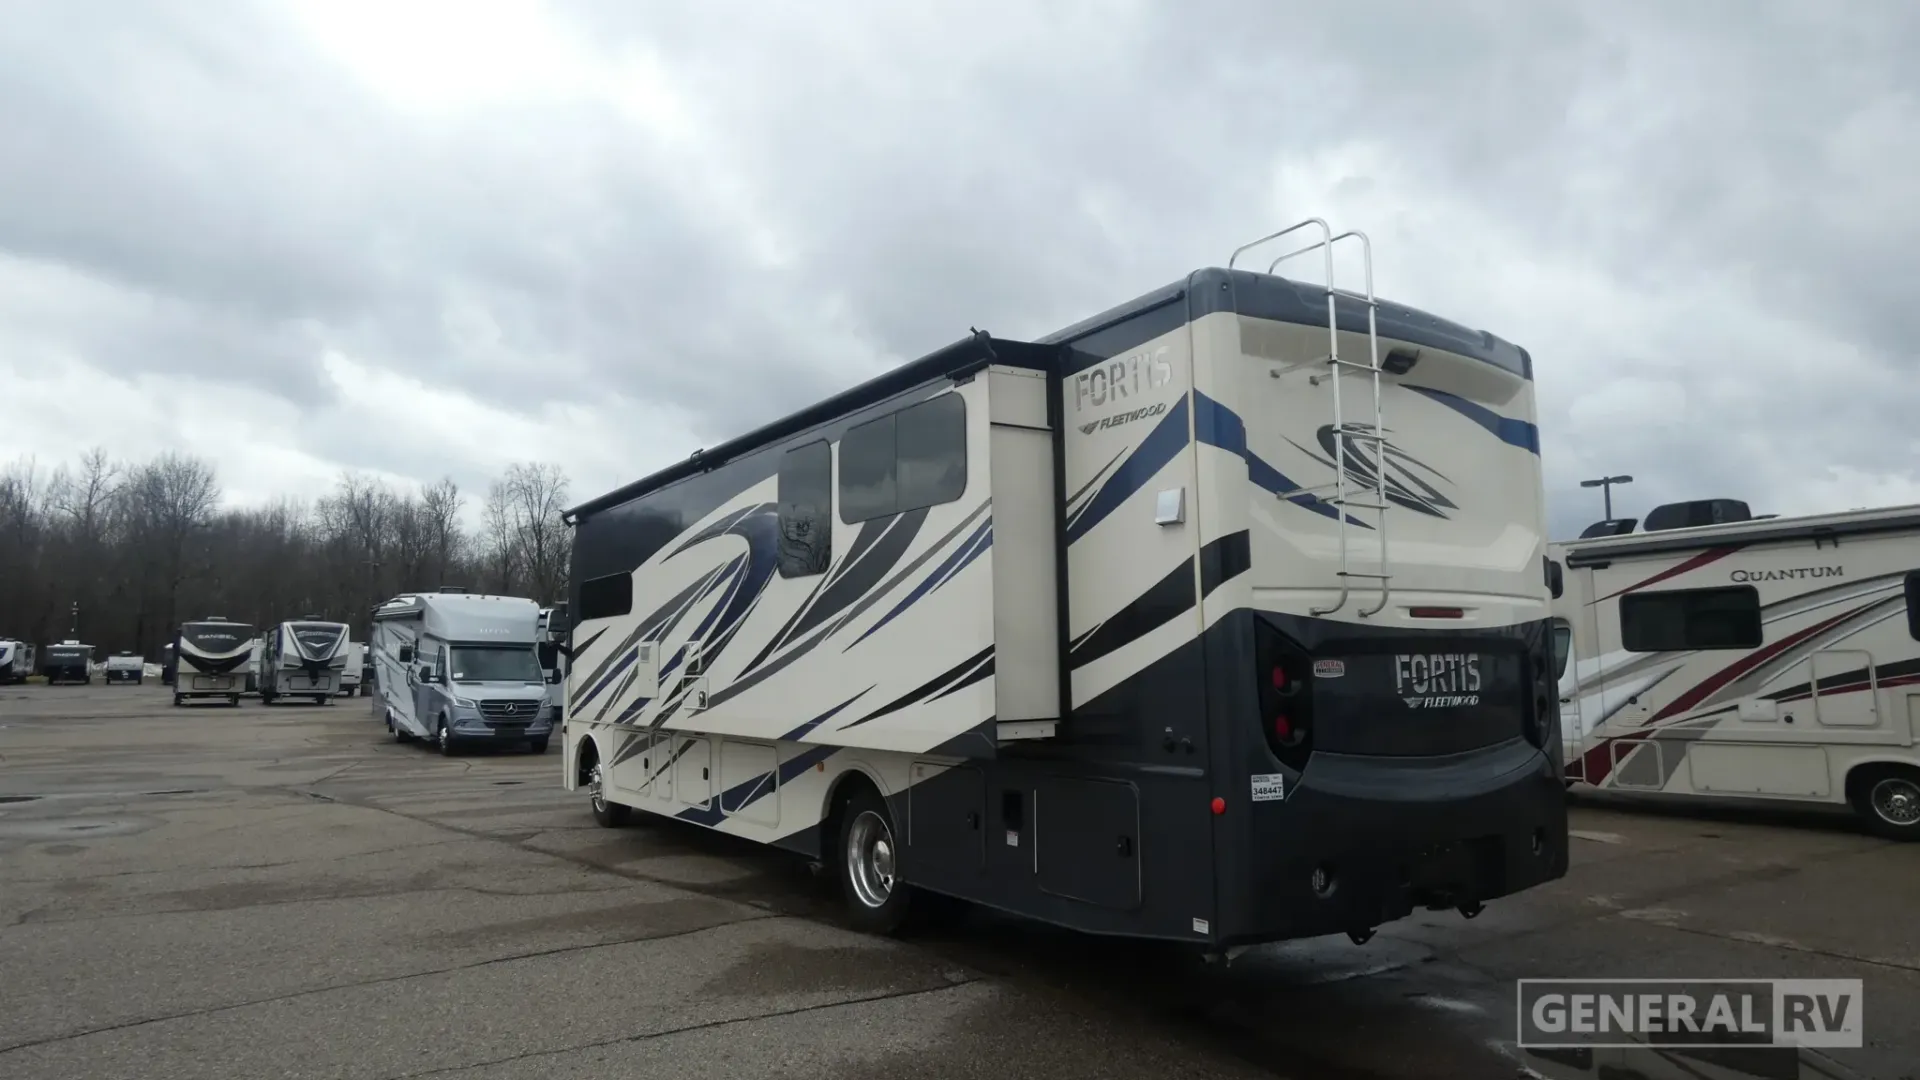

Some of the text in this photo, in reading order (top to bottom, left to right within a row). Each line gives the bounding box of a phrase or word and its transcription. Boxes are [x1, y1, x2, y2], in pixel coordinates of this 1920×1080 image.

[1074, 345, 1173, 412] FORTIS
[1100, 402, 1167, 431] FLEETWOOD
[1395, 653, 1481, 695] FORTIS
[1424, 695, 1480, 709] FLEETWOOD
[1253, 786, 1283, 796] 348447
